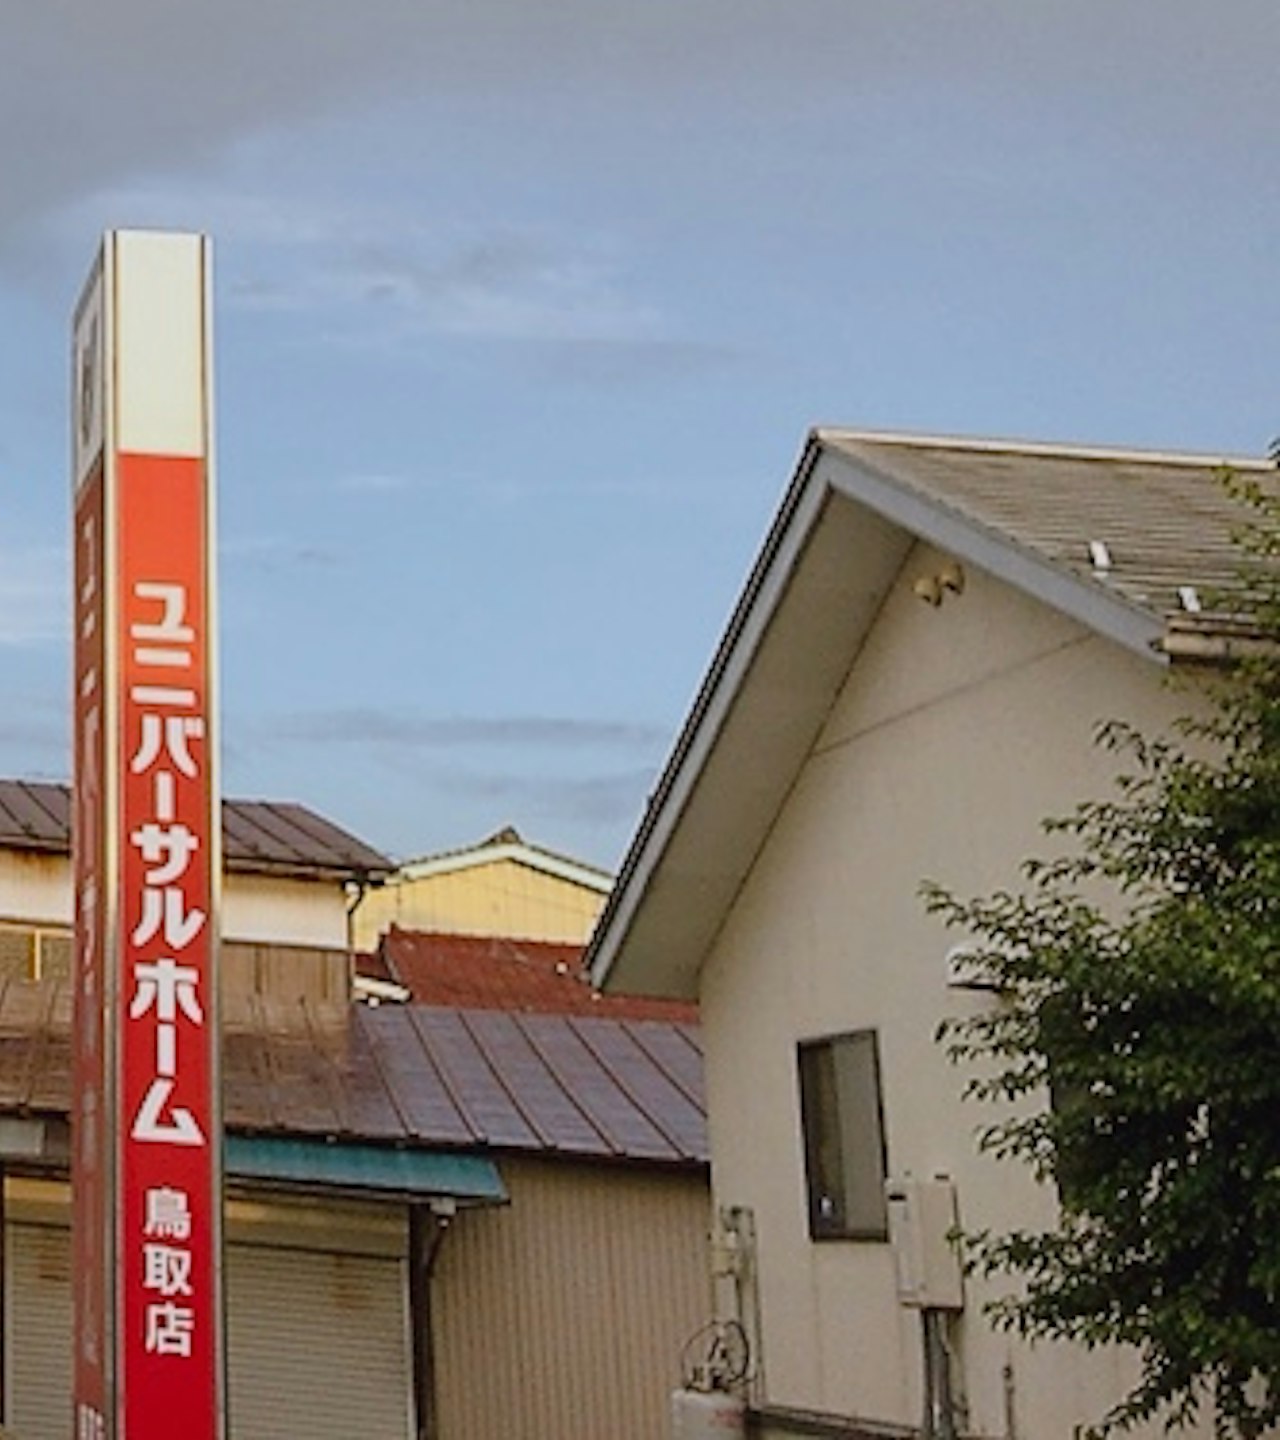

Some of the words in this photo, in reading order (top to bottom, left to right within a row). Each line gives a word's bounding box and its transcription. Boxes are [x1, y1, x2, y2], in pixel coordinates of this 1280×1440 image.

[130, 582, 206, 1146] ユニバーサルホーム
[142, 1187, 195, 1357] 鳥取店
